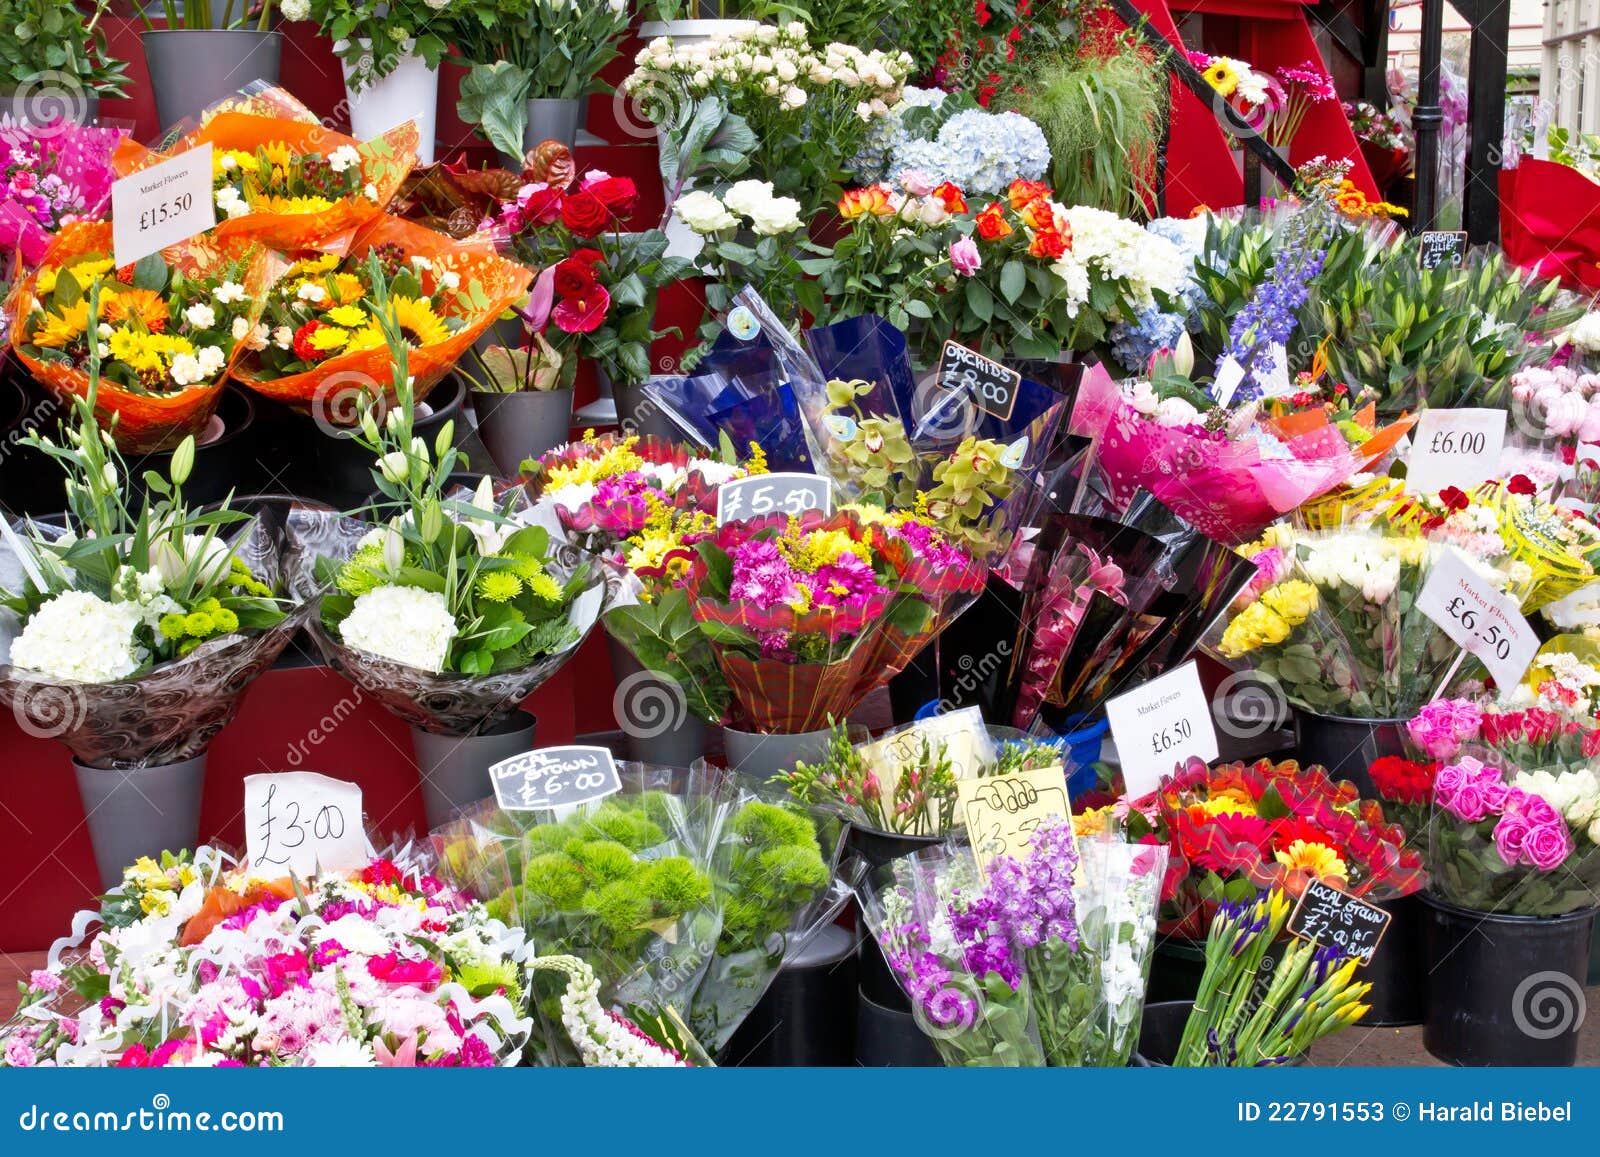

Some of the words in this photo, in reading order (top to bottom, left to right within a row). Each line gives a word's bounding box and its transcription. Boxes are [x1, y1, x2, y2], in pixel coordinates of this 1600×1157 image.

[140, 180, 163, 195] Market
[164, 170, 189, 184] Flowers
[139, 192, 192, 232] £15.50
[946, 345, 1011, 383] ORCHIDS
[1429, 431, 1485, 455] £6.00
[1458, 578, 1487, 609] Market
[1488, 604, 1519, 640] Flowers
[1445, 597, 1510, 660] £6.50
[1137, 701, 1160, 716] Market
[1152, 718, 1191, 755] £6.50
[497, 753, 560, 779] LOCAL
[1308, 880, 1342, 907] LOCAL
